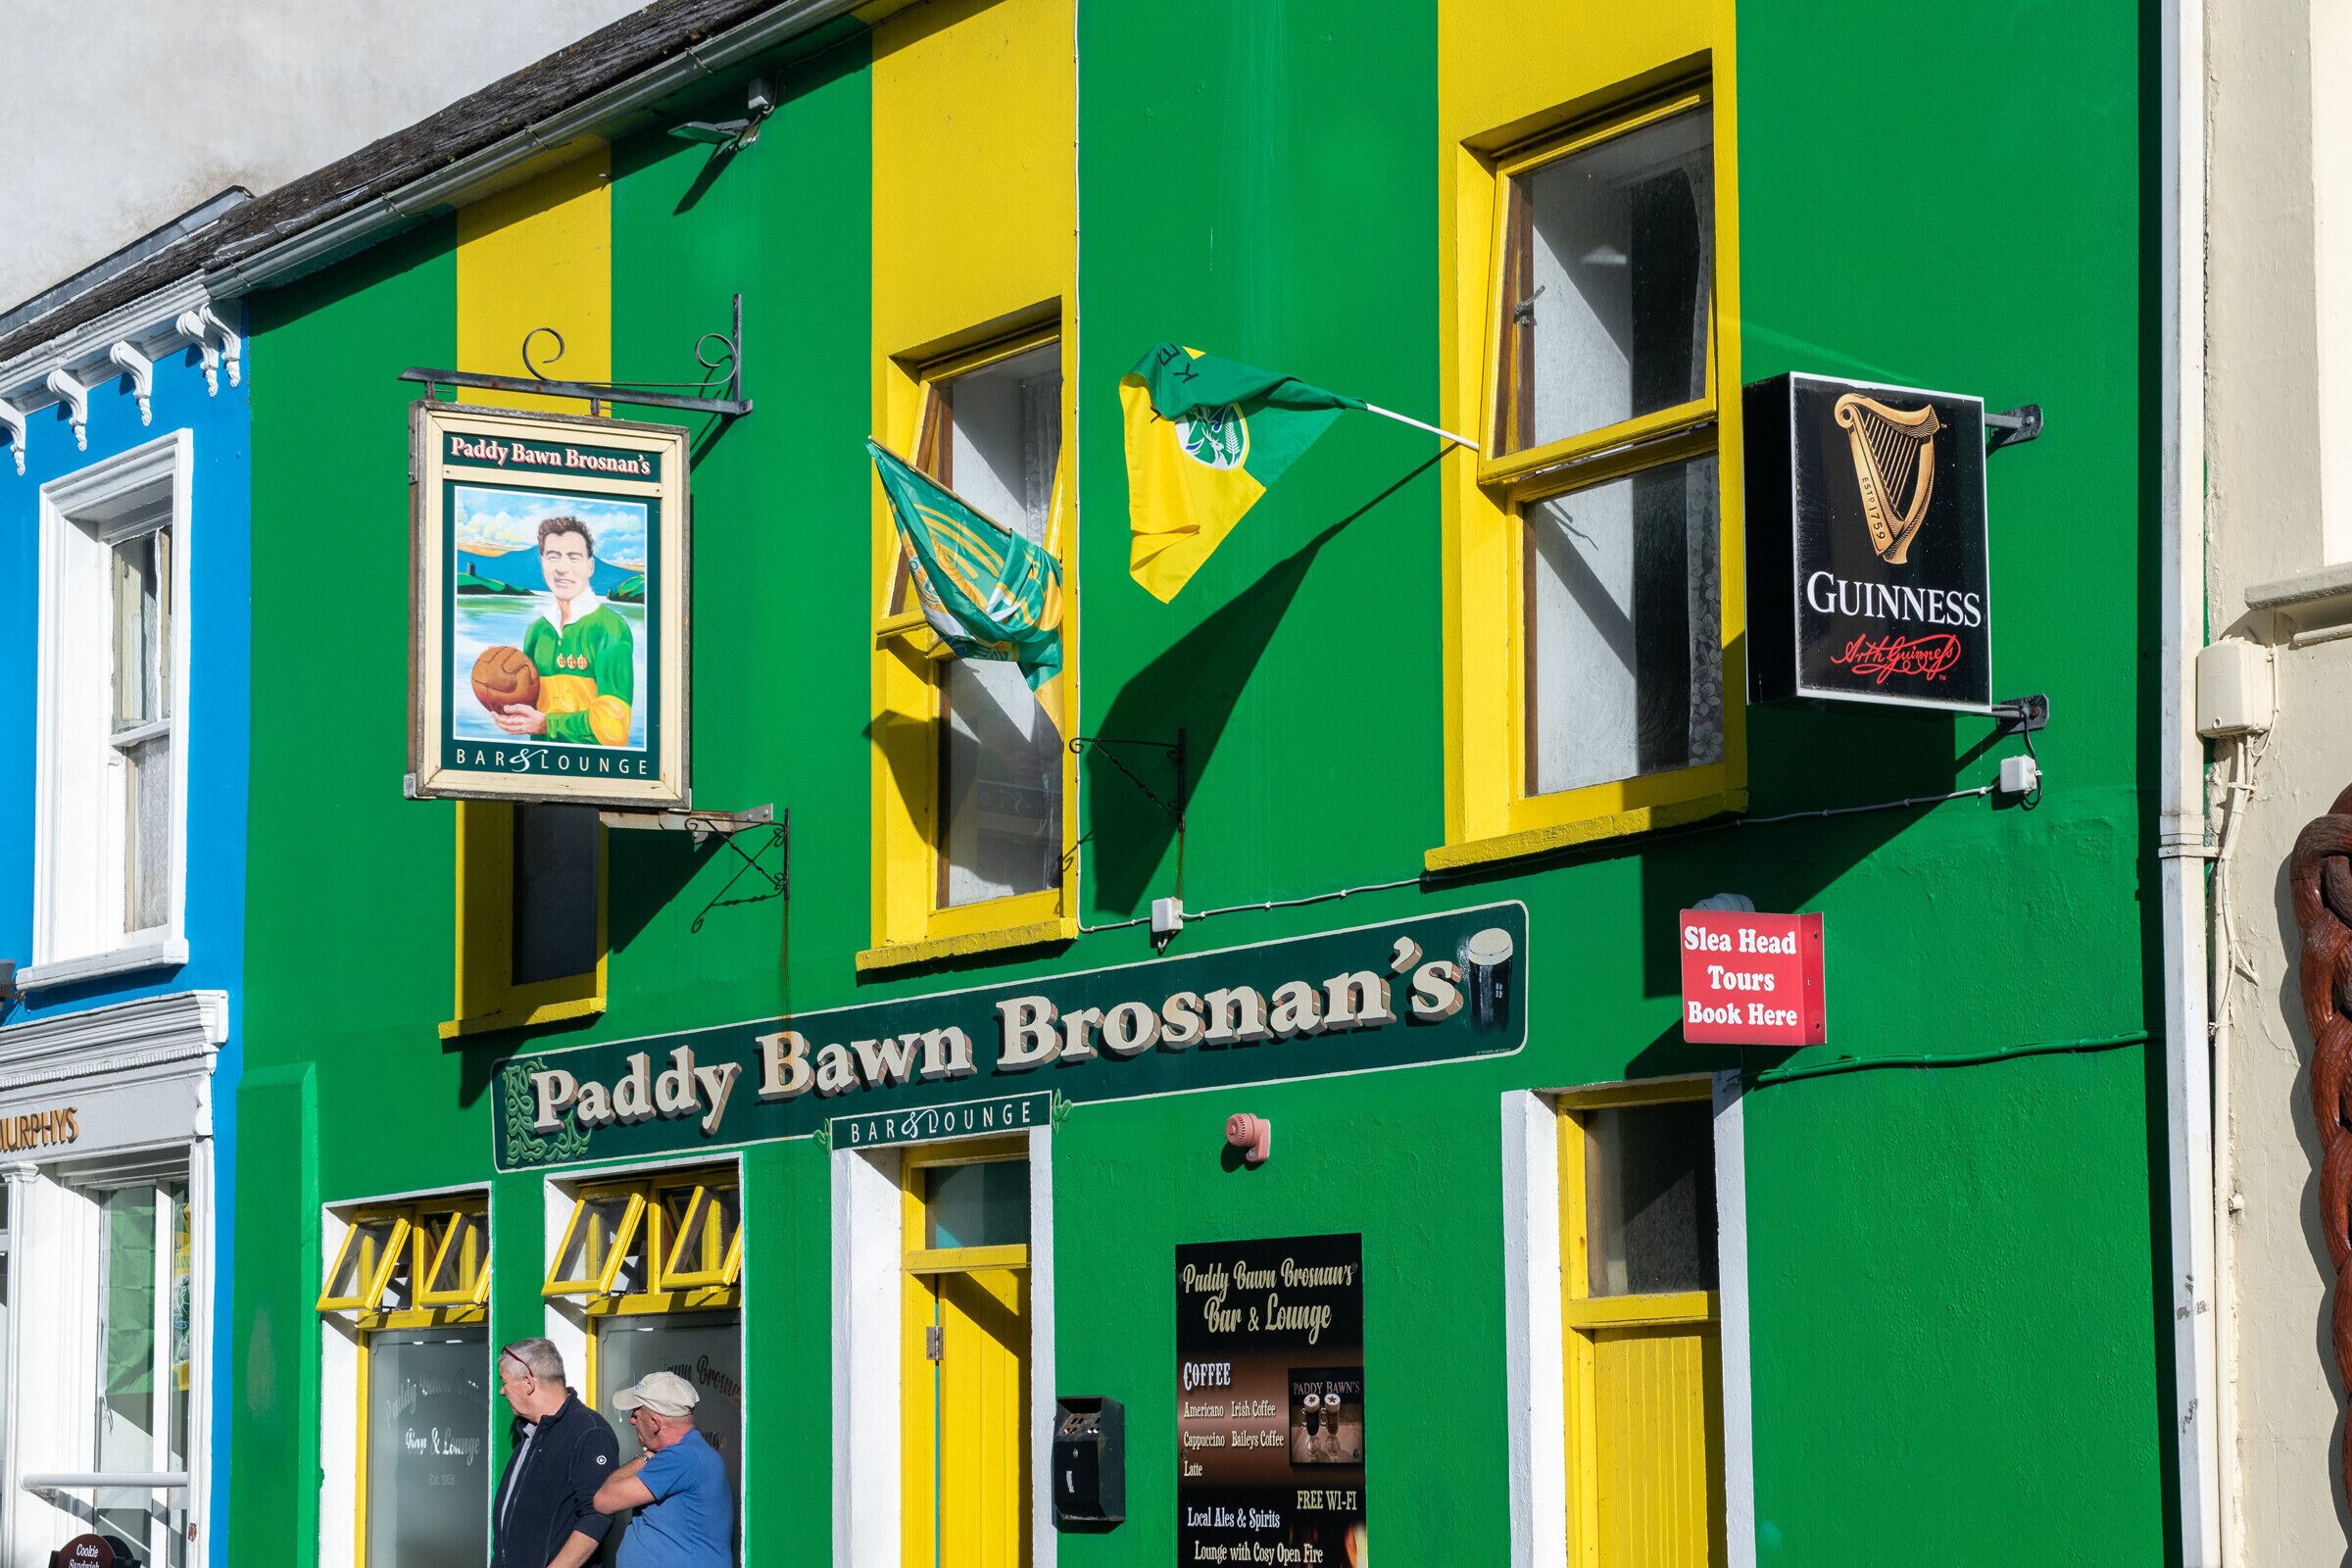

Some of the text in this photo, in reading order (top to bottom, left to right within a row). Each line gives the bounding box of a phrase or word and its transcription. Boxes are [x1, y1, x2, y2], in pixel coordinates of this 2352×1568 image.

[451, 437, 651, 475] Paddy Bawn Brosnan's
[1868, 506, 1886, 540] 1759
[1806, 570, 1982, 628] GUINNESS
[457, 748, 647, 775] BAR & LOUNGE
[1684, 925, 1796, 955] Slea Head
[1707, 964, 1775, 992] Tours
[1688, 1001, 1797, 1026] Book Here
[531, 936, 1464, 1136] Paddy Bawn Brosnan's
[851, 1102, 1031, 1144] BAR & LOUNGE
[1183, 1257, 1352, 1302] Paddy Bawn Brosnan's
[1203, 1293, 1333, 1346] Bar & Lounge
[1183, 1361, 1231, 1392] COFFEE
[1294, 1381, 1360, 1395] PADDY BAWN'S
[1184, 1399, 1277, 1418] Americano Irish Coffee
[1183, 1430, 1285, 1450] Cappuccino Baileys Coffee
[1184, 1460, 1203, 1477] Latte
[1297, 1490, 1357, 1511] FREE WI-FI
[1188, 1506, 1281, 1532] Local Ales & Spirits
[76, 1544, 99, 1557] Cookie
[1194, 1540, 1323, 1568] Lounge with Cosy Open Fire
